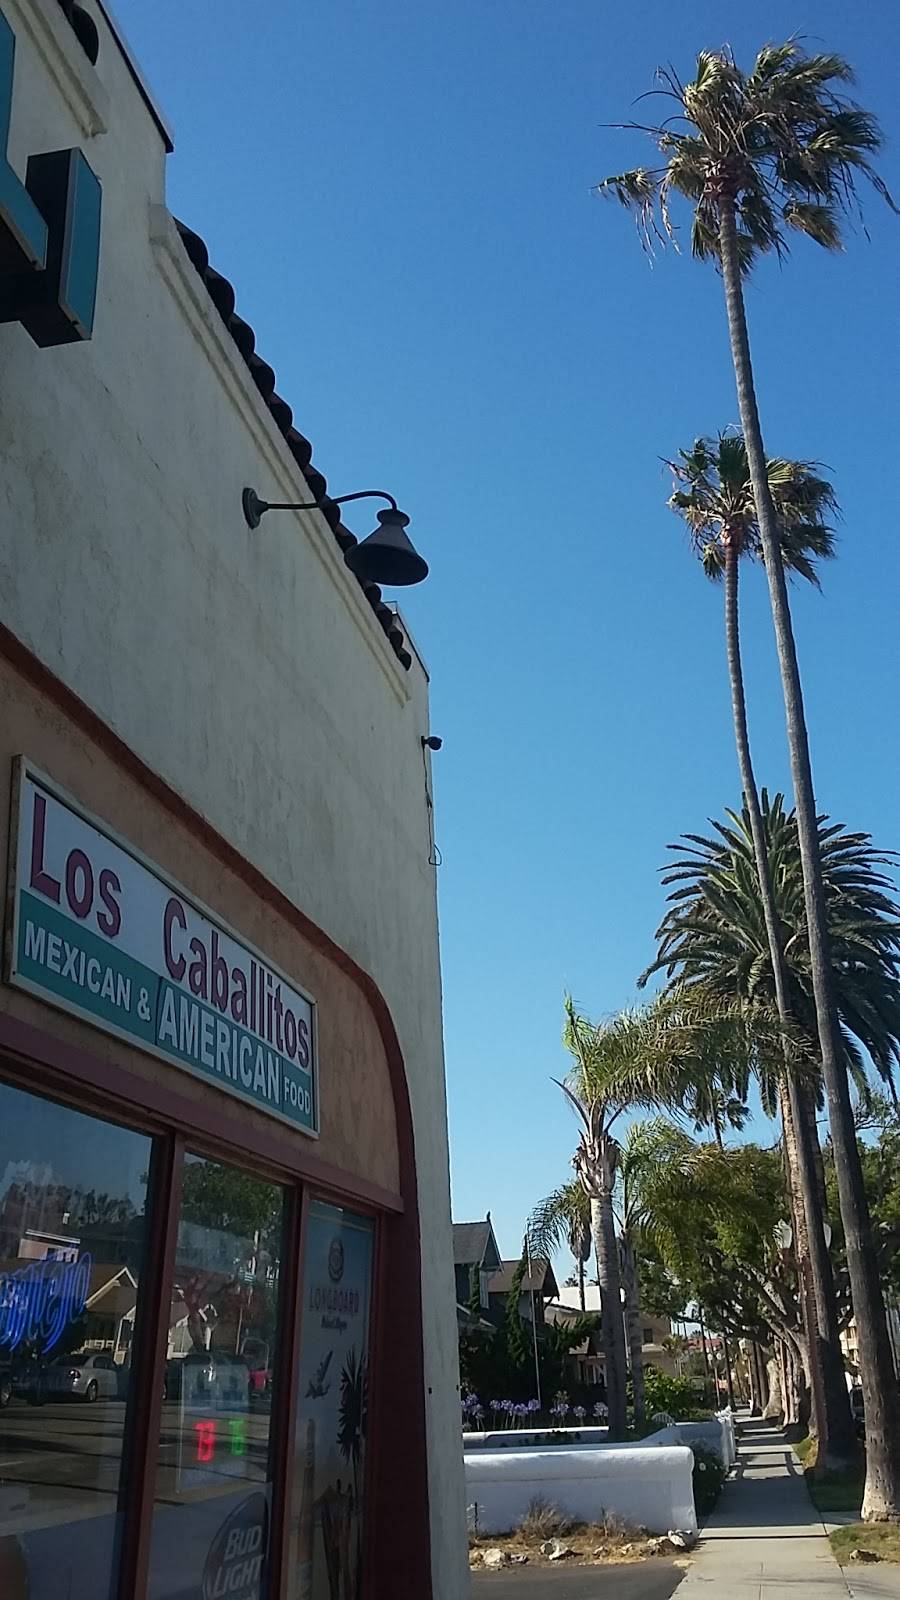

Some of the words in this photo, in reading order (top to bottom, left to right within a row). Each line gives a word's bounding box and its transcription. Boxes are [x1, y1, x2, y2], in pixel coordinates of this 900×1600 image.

[24, 920, 132, 1012] MEXICAN
[137, 987, 151, 1023] &
[158, 986, 281, 1105] AMERICAN
[284, 1075, 311, 1116] FOOD
[163, 897, 310, 1070] Caballitos
[212, 1554, 265, 1598] LIGHT
[224, 1525, 263, 1562] BUD
